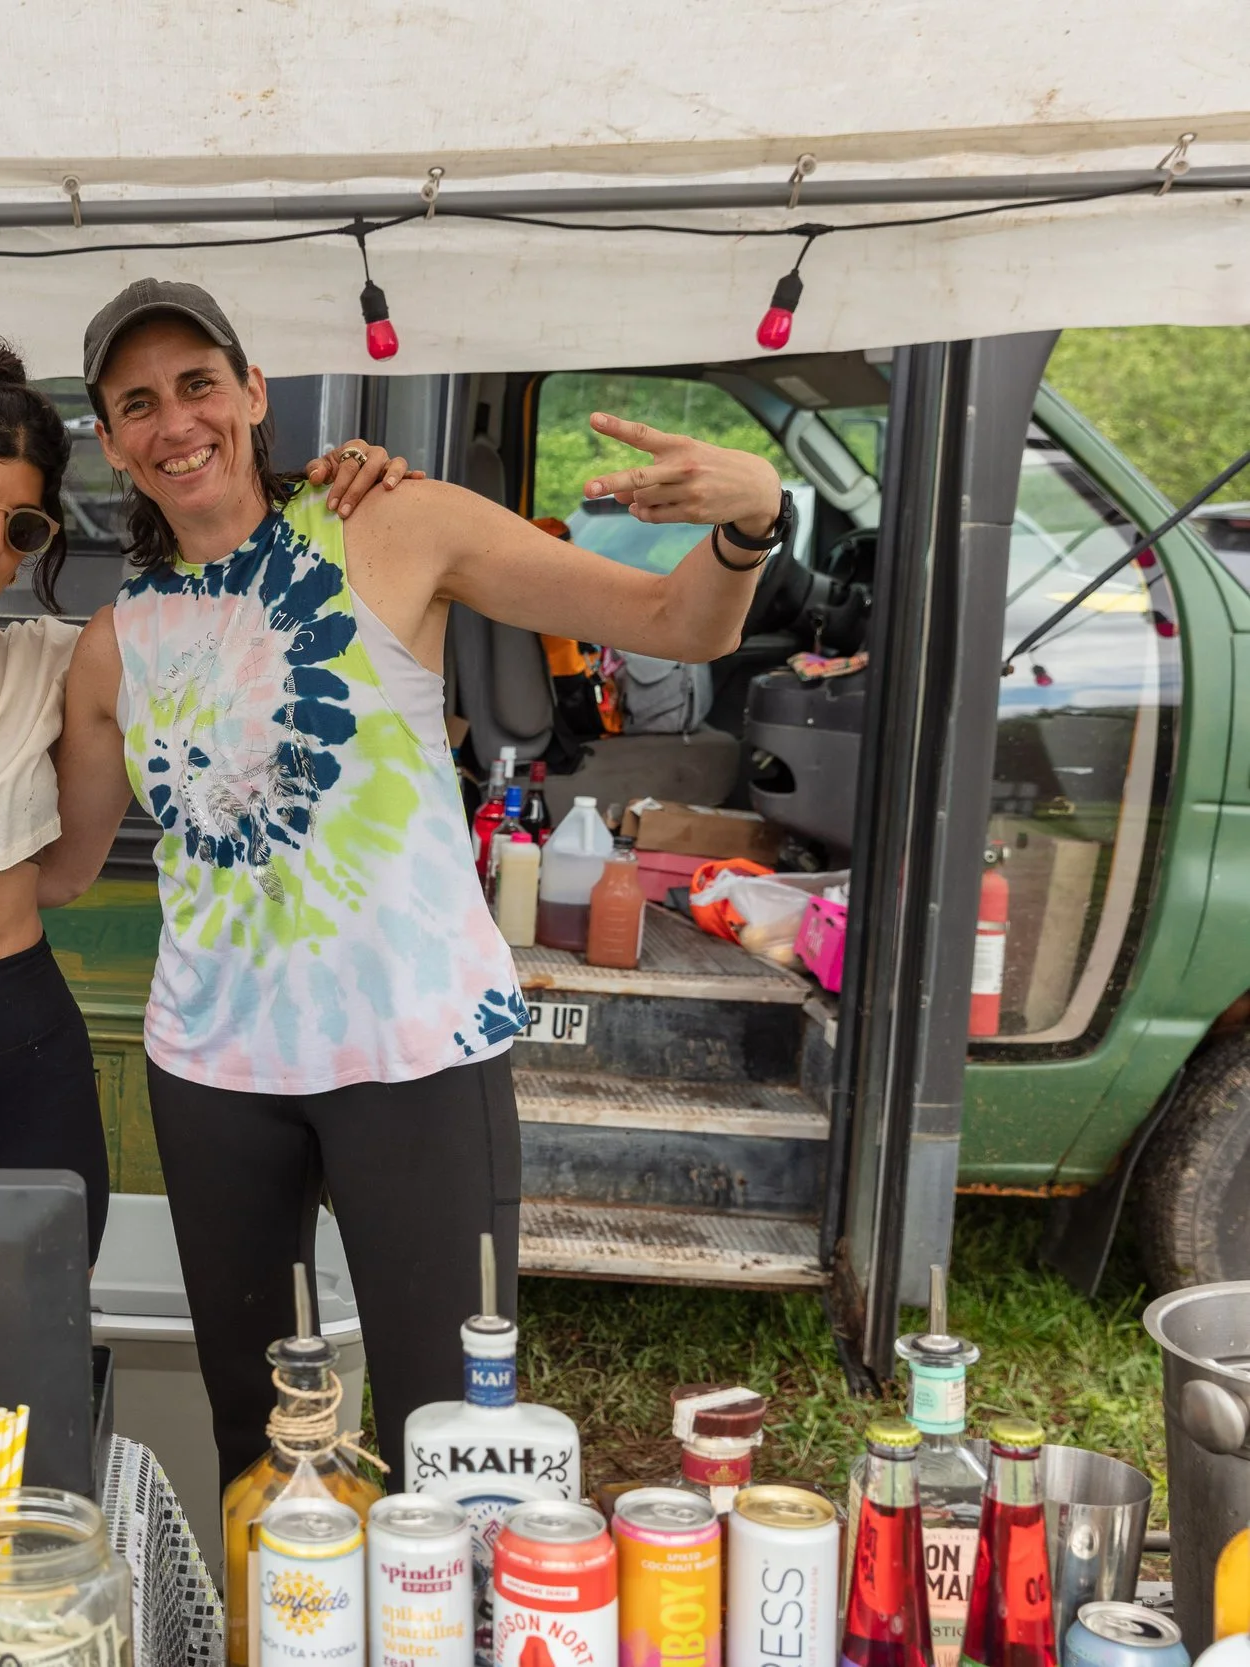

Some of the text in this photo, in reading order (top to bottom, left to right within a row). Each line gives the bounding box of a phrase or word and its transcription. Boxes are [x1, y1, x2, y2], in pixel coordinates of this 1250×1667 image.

[553, 1007, 583, 1039] UP
[471, 1369, 512, 1387] KAH
[449, 1446, 536, 1474] KAH
[381, 1559, 463, 1584] spindrift
[261, 1571, 350, 1618] Surfside
[760, 1567, 804, 1667] ESS
